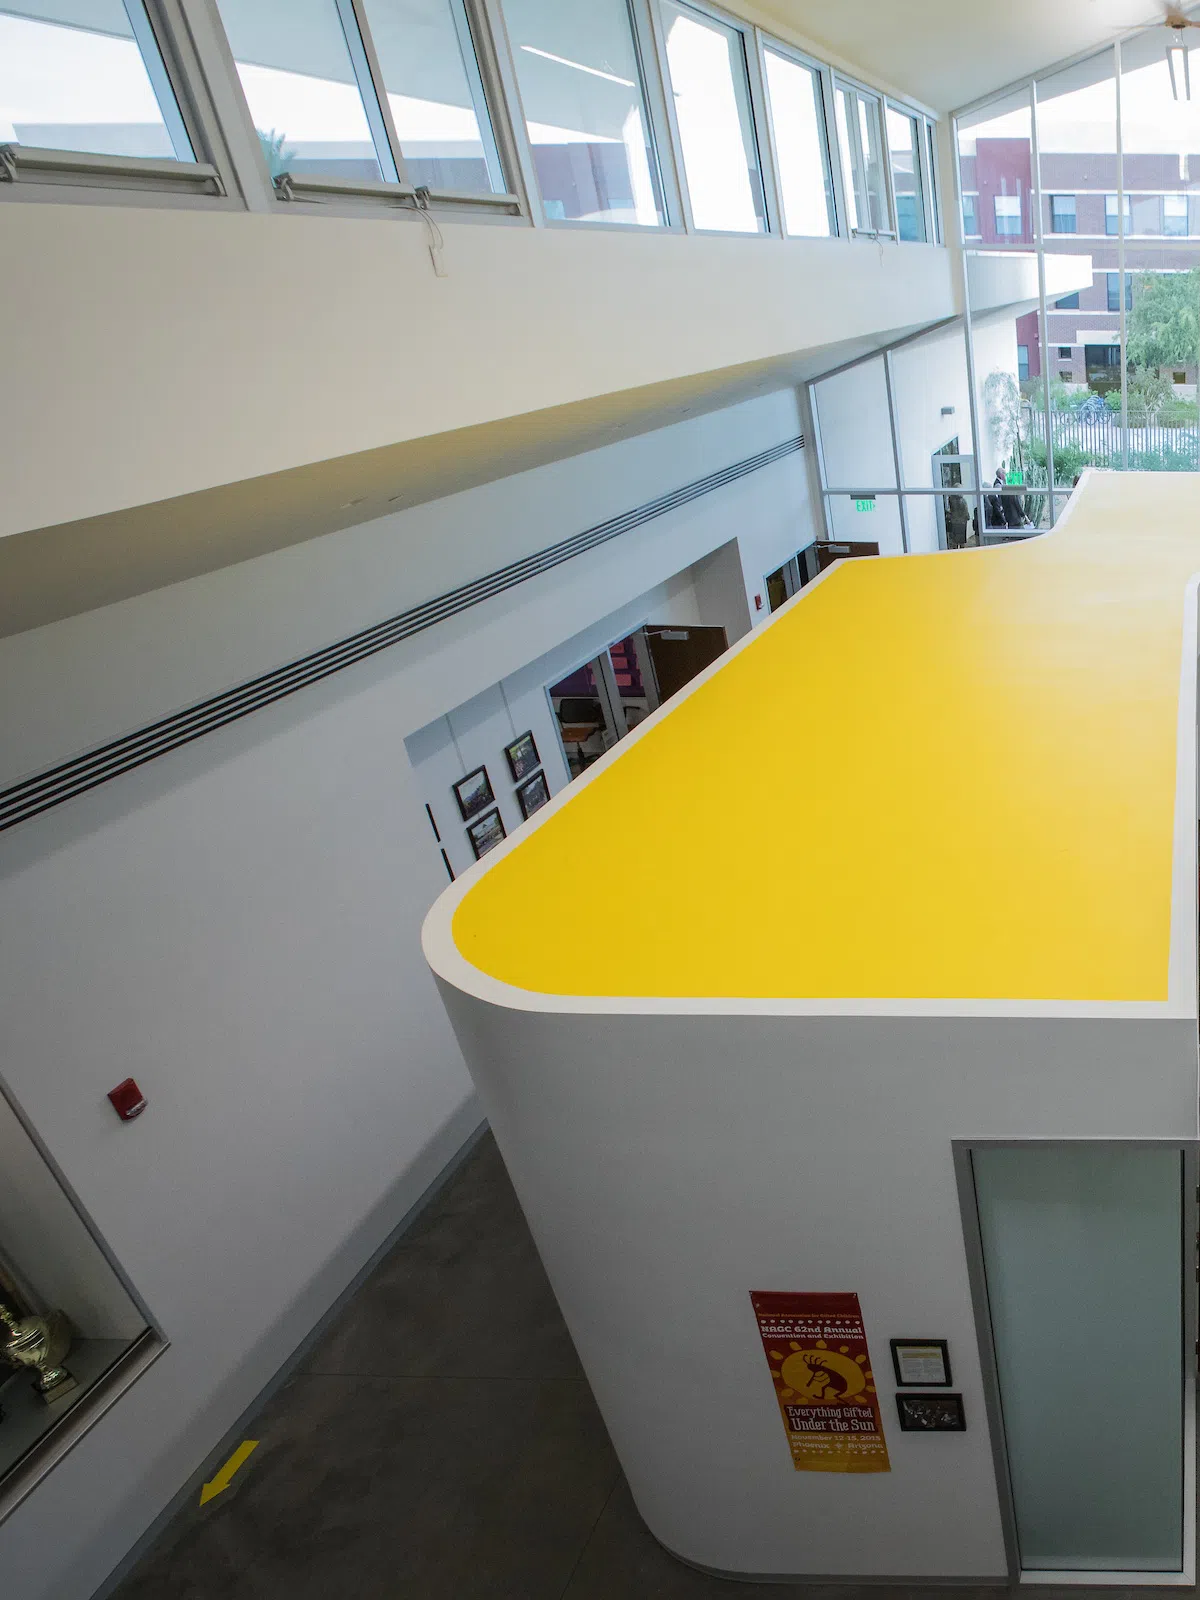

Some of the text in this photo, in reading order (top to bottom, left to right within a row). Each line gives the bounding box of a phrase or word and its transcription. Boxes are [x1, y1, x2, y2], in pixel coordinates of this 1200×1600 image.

[760, 1325, 863, 1334] NAGC 62nd Annual
[787, 1406, 874, 1418] Everything Gifted
[792, 1418, 875, 1431] Under the Sun
[792, 1441, 829, 1449] Phoenix
